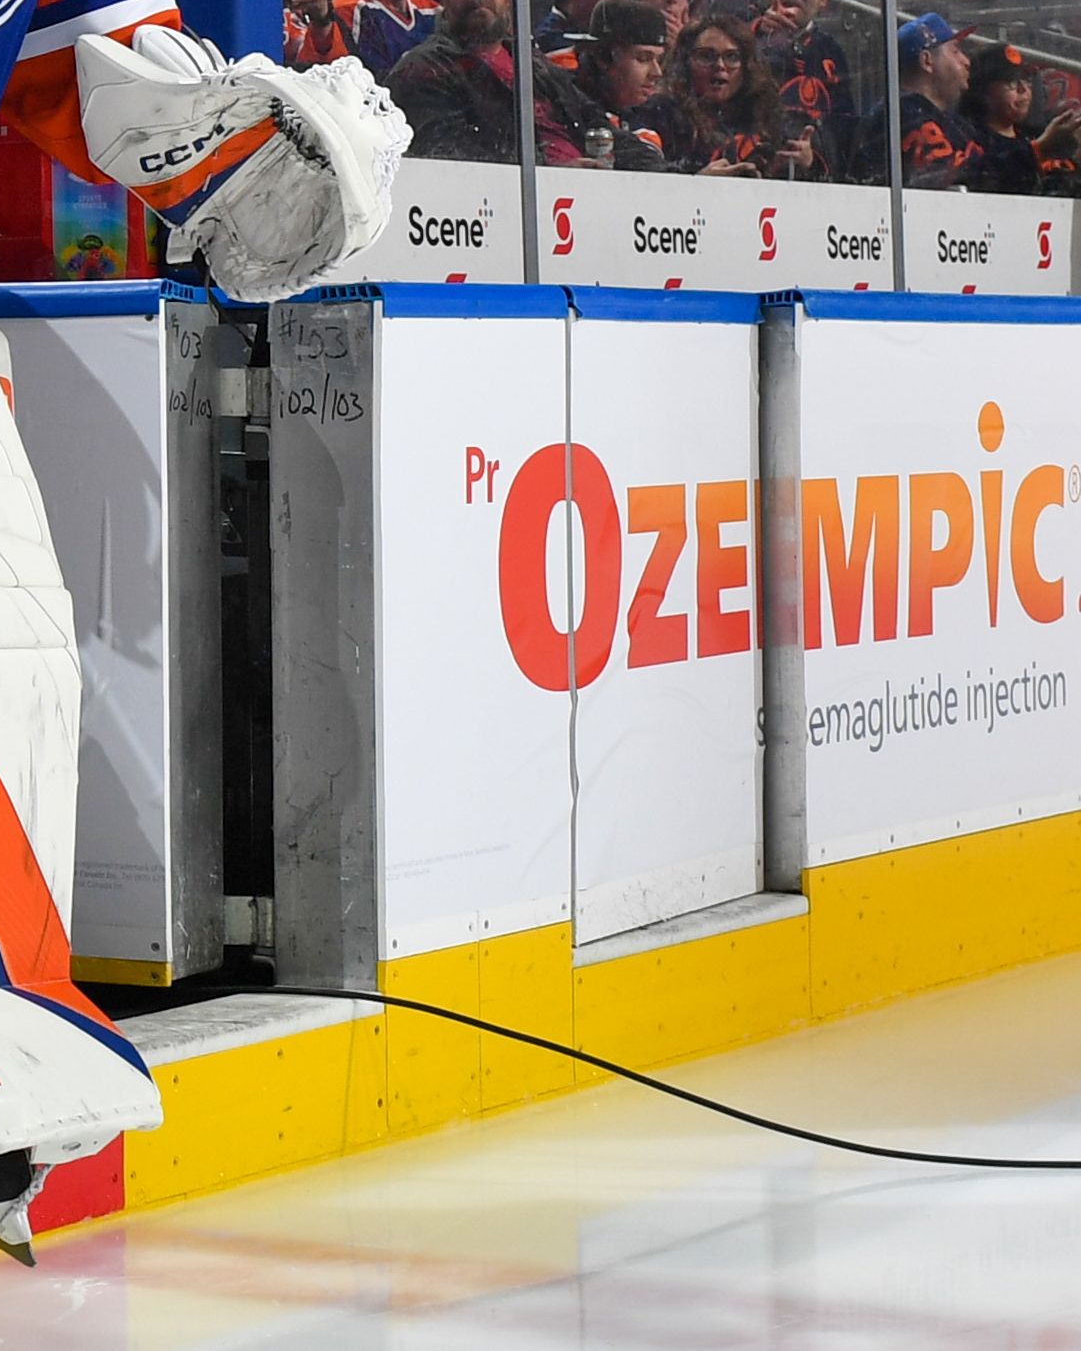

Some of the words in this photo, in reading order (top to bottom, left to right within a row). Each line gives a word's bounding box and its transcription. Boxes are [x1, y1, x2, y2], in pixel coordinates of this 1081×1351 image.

[139, 122, 226, 174] CCM
[465, 446, 500, 504] Pr
[965, 662, 1068, 731] injection
